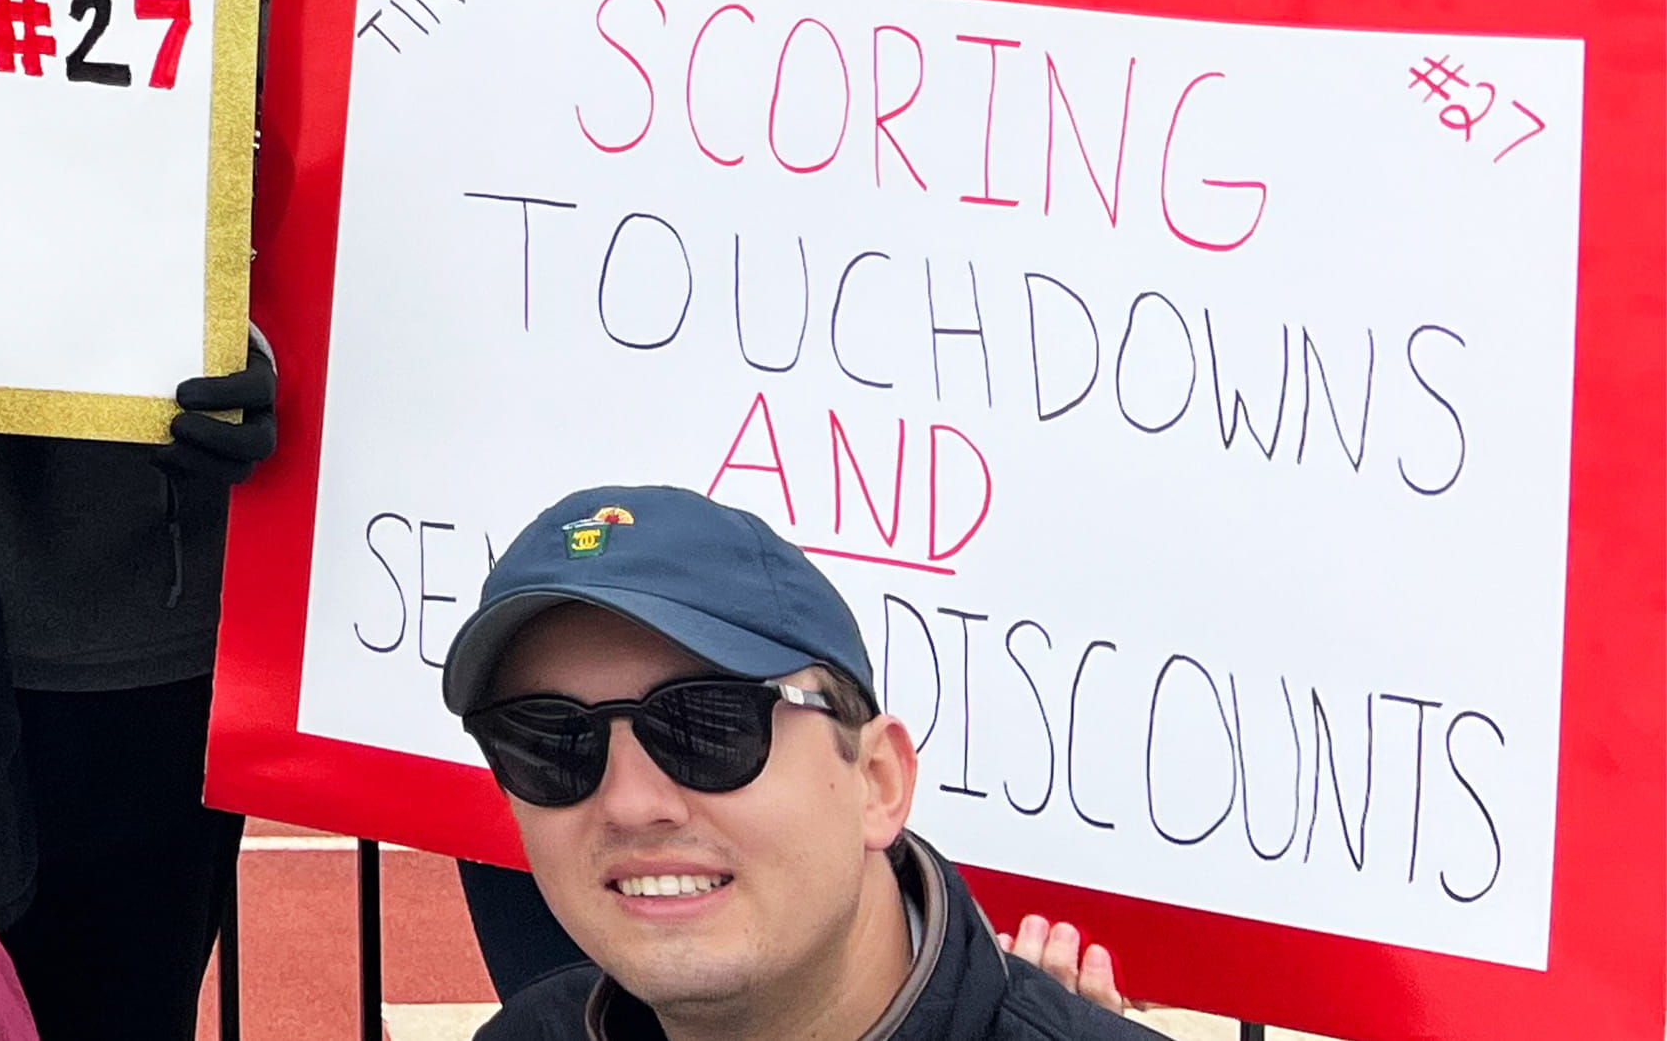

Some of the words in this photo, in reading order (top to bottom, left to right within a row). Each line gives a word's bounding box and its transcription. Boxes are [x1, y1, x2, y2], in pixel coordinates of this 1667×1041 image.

[1408, 54, 1546, 163] #27
[462, 190, 1468, 496] TOUCHDOWNS
[705, 392, 992, 560] AND
[882, 593, 1505, 904] DISCOUNTS
